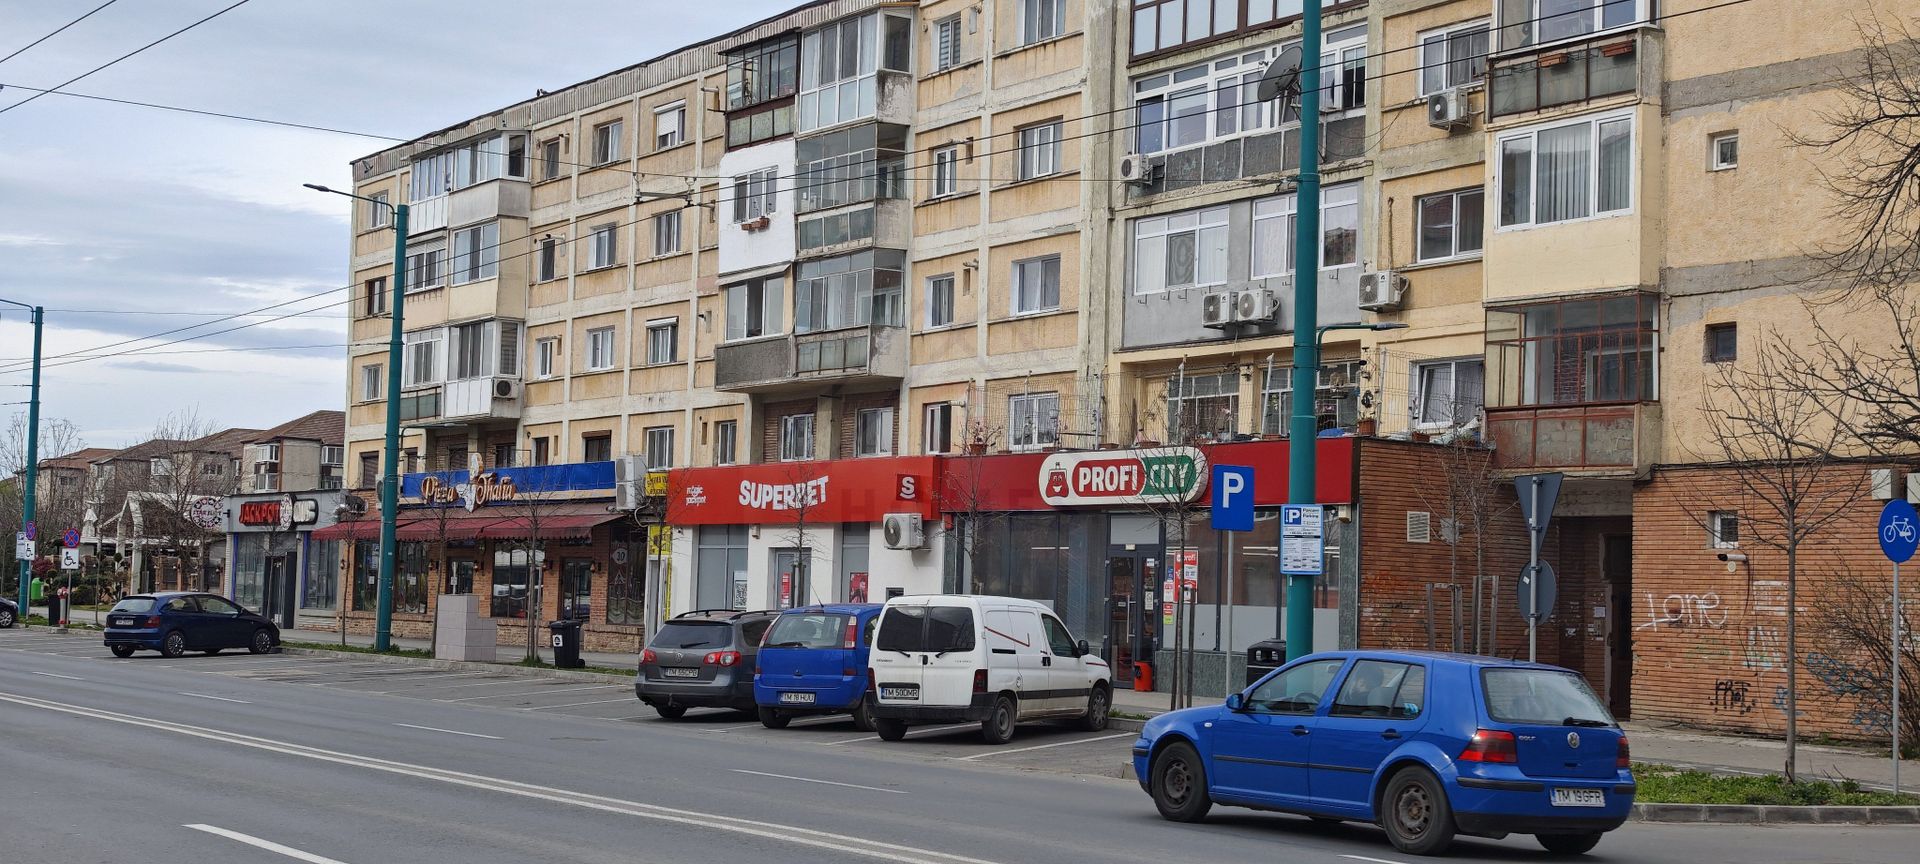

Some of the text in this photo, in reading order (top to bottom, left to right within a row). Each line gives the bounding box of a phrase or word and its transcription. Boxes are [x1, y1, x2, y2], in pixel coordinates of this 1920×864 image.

[1078, 463, 1189, 492] PROFI CITY
[1222, 472, 1244, 508] P
[738, 475, 830, 511] SUPERBET
[239, 502, 280, 524] JACKPOT
[885, 688, 895, 696] TM
[1556, 789, 1571, 802] TM
